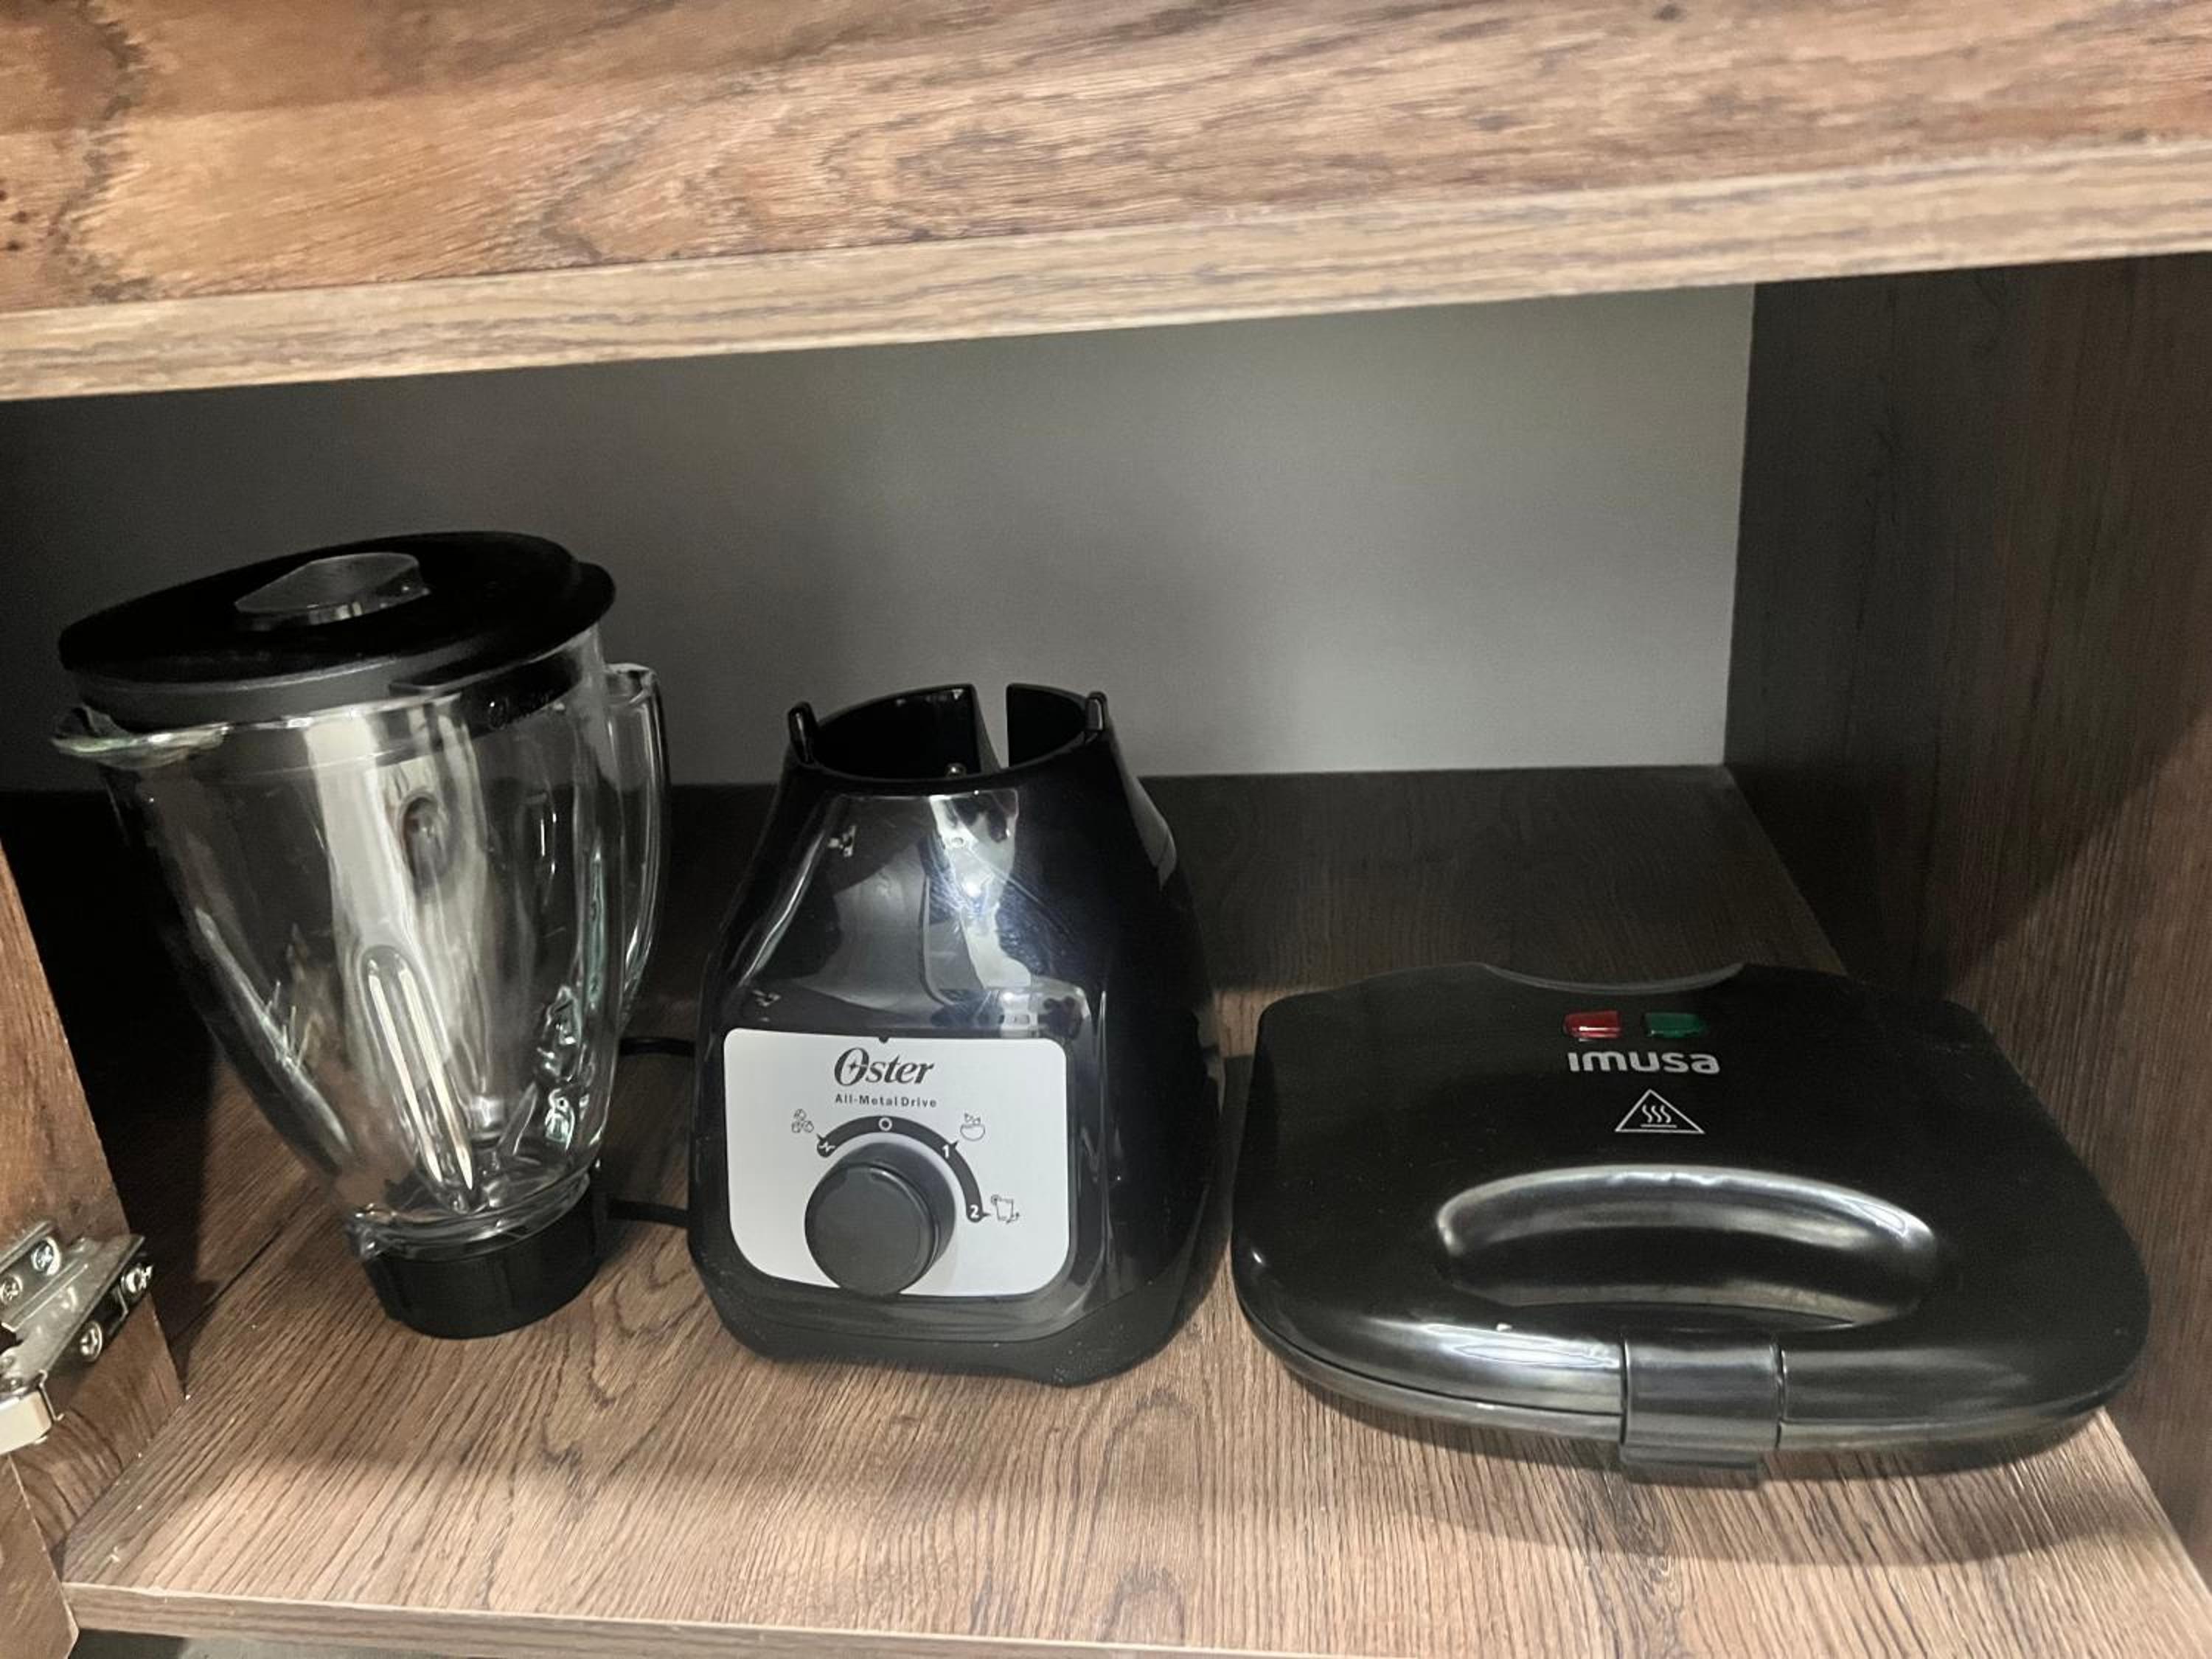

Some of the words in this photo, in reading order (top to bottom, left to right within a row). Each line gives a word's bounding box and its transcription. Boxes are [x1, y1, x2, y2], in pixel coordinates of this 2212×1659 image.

[834, 1047, 934, 1086] Oster
[1568, 1051, 1720, 1074] imusa
[942, 1144, 950, 1159] 1
[970, 1203, 980, 1219] 2
